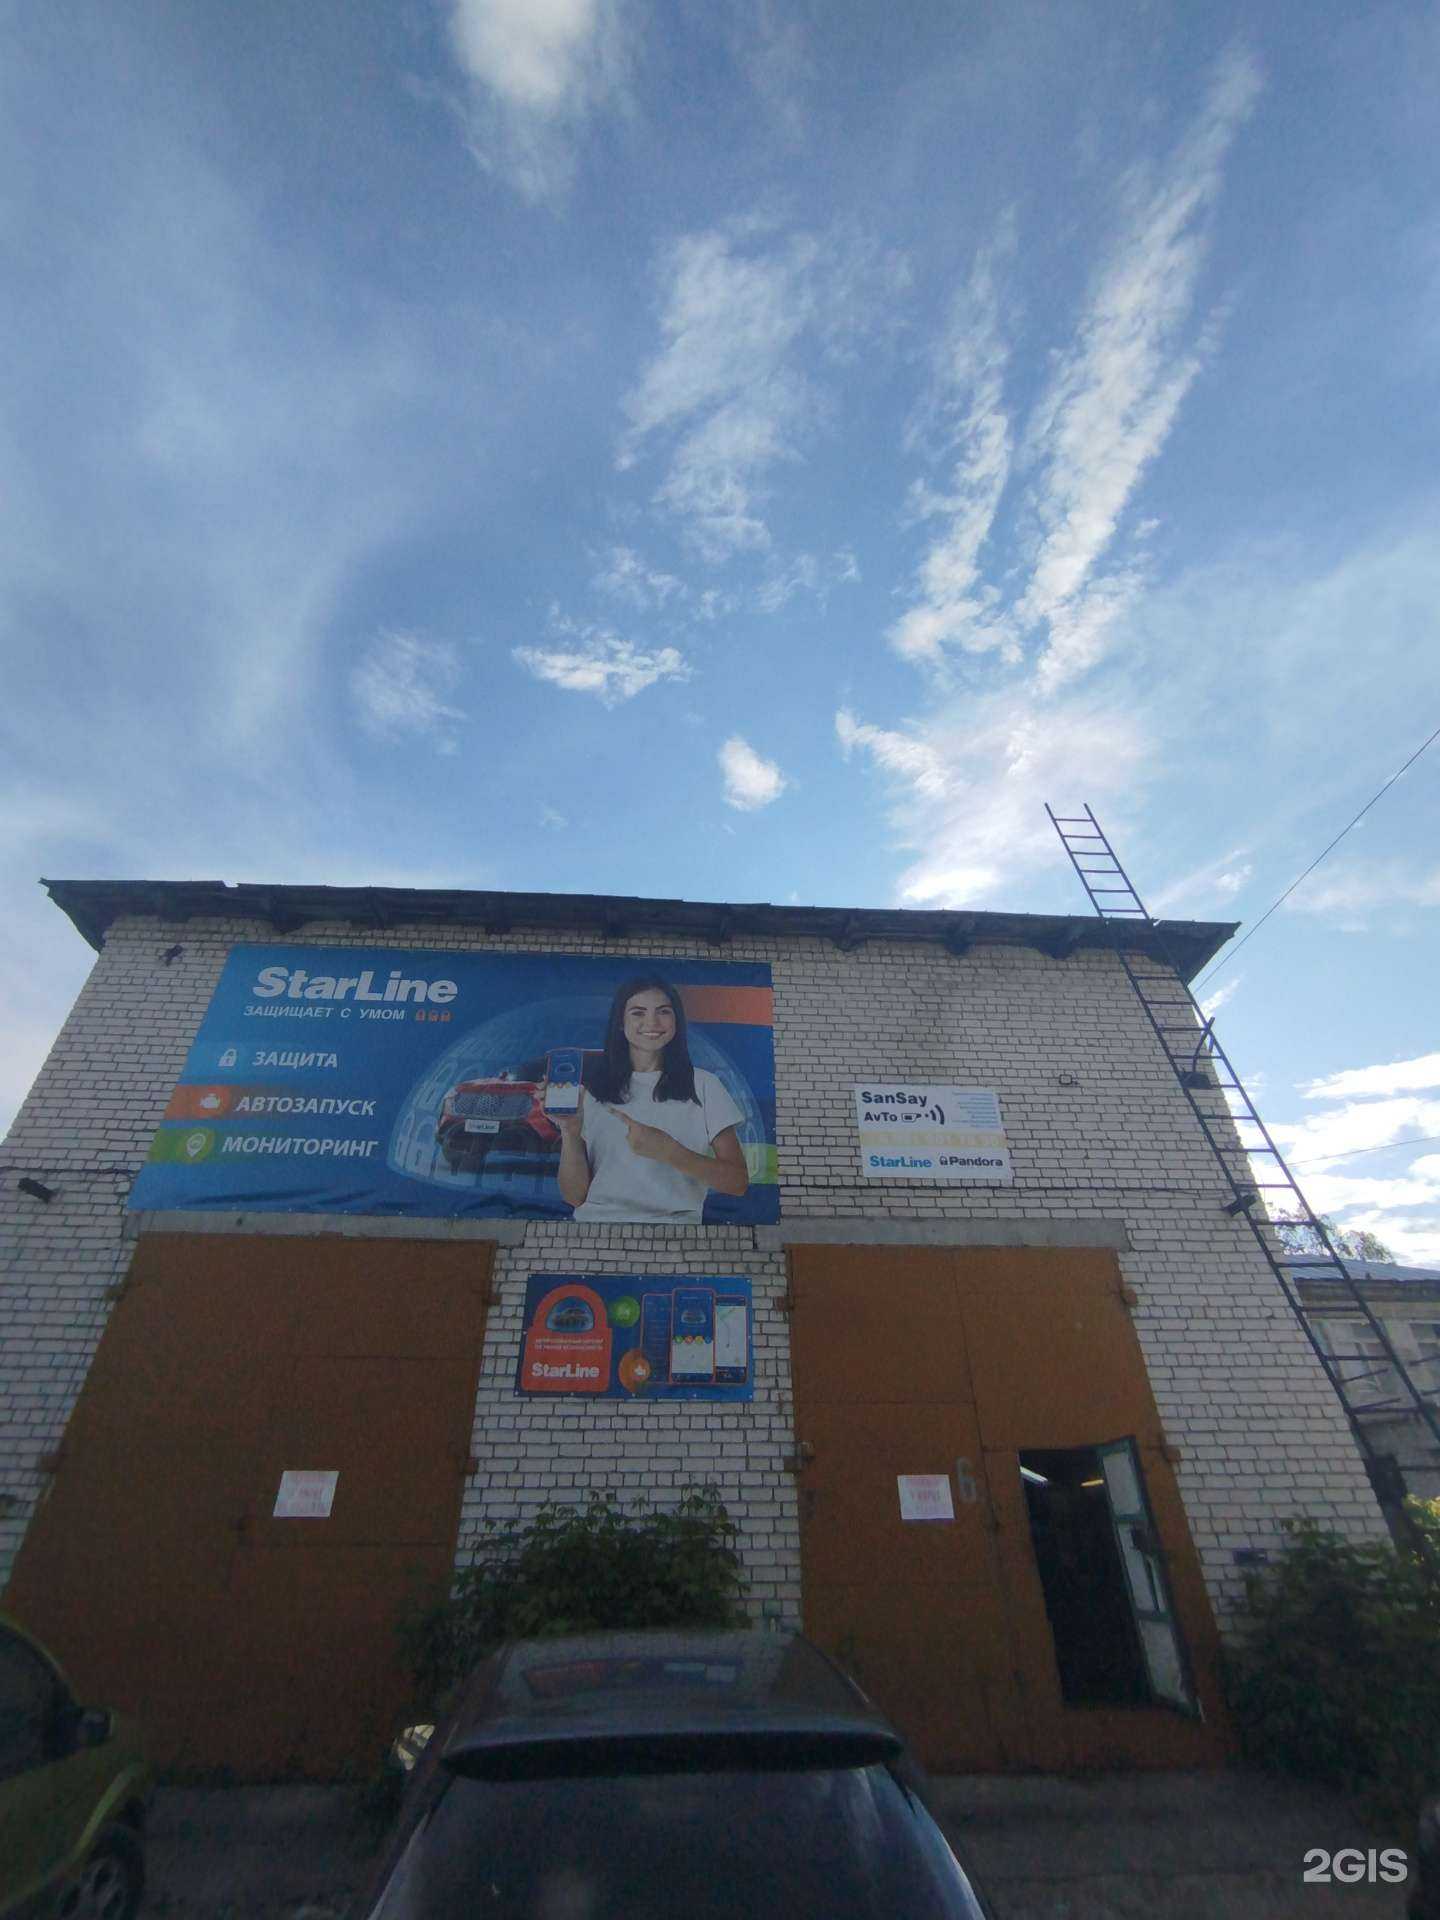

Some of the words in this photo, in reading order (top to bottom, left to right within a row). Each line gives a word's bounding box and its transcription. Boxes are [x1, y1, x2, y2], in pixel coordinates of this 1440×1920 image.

[252, 966, 458, 1003] StarLine
[243, 1005, 334, 1018] ЗАЩИЩАЕТ
[359, 1009, 405, 1020] УМОМ
[252, 1050, 339, 1069] ЗАЩИТА
[234, 1096, 377, 1117] АВТОЗАПУСК
[861, 1091, 928, 1108] SanSay
[221, 1135, 378, 1158] МОНИТОРИНГ
[869, 1155, 933, 1168] StarLine
[949, 1156, 1004, 1167] Pandora
[531, 1362, 600, 1379] StarLine
